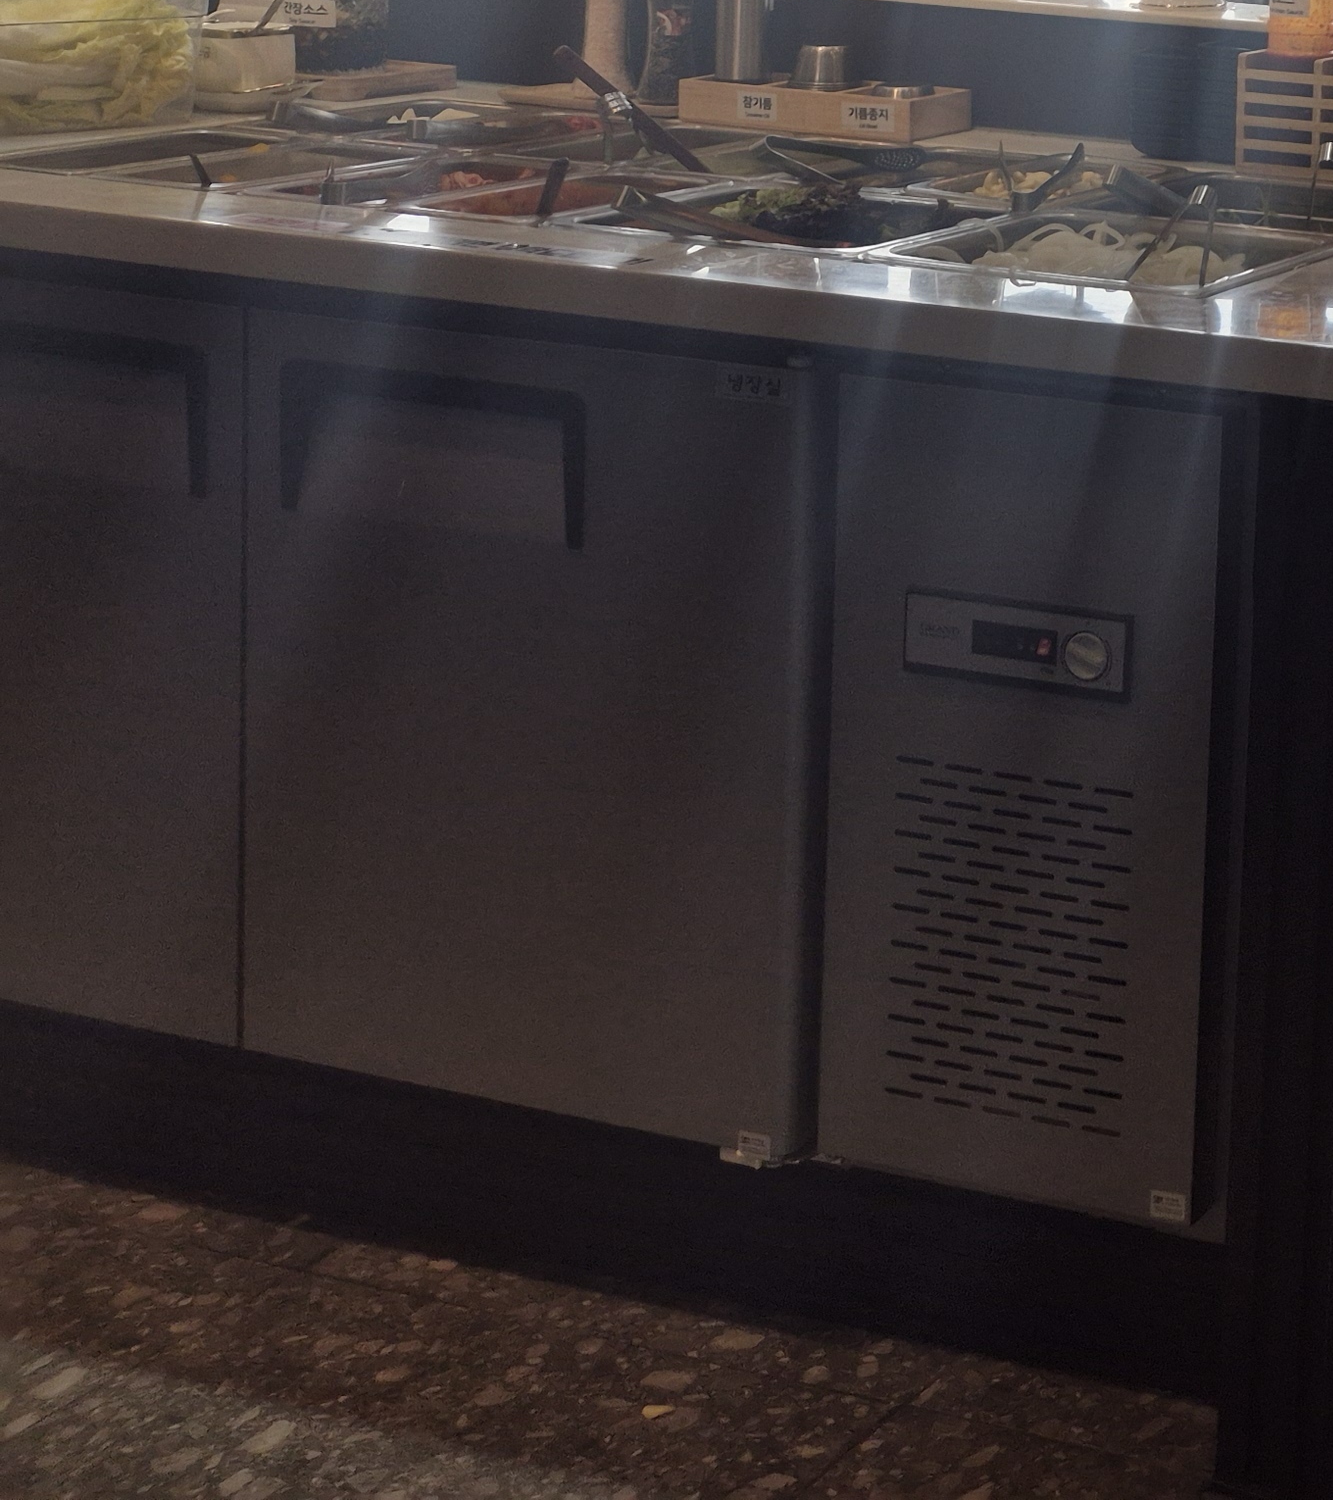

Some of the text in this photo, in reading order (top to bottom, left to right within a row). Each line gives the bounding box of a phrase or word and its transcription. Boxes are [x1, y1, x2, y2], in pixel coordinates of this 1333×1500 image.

[284, 1, 329, 15] 간장소스
[742, 95, 773, 110] 참기름
[848, 106, 889, 121] 기름종지
